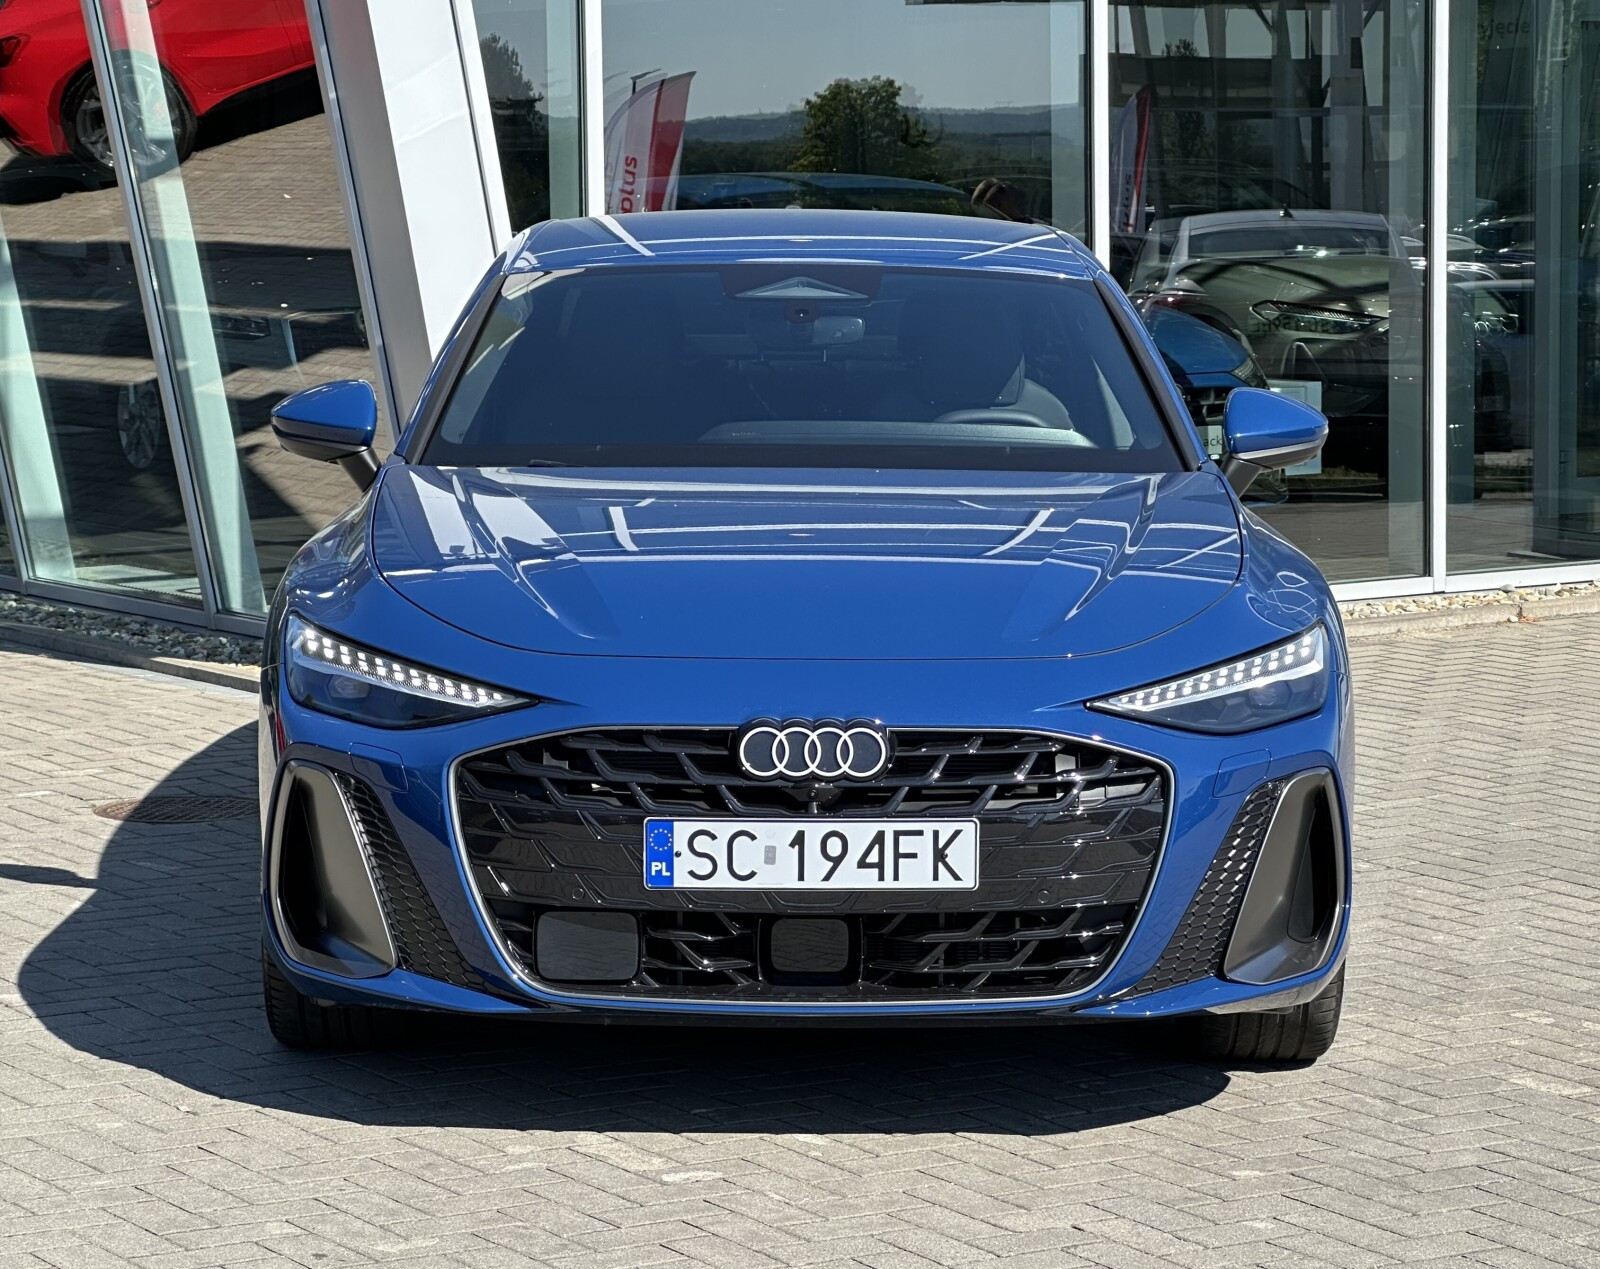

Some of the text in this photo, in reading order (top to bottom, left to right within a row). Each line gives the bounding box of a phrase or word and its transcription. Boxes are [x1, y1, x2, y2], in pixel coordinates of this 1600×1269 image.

[651, 862, 671, 876] PL
[687, 829, 964, 882] SC 194FK
